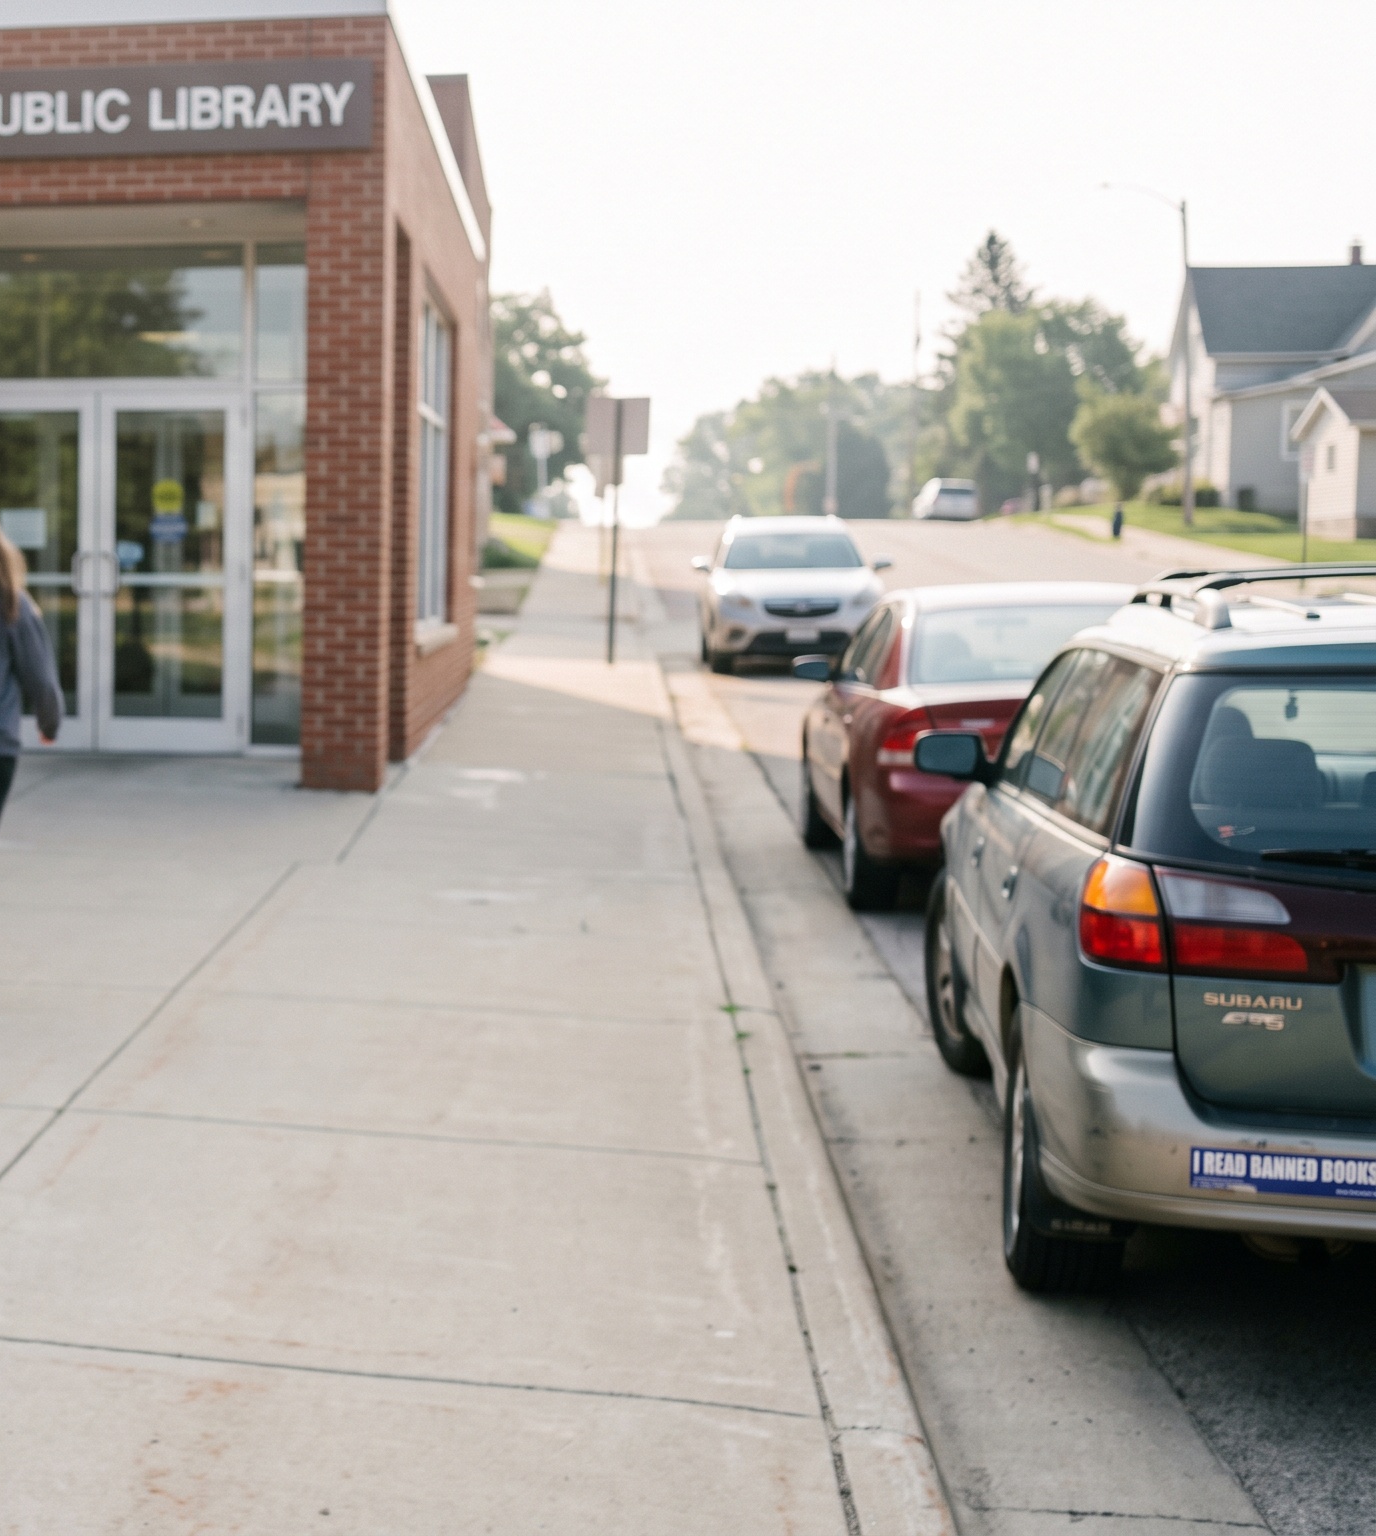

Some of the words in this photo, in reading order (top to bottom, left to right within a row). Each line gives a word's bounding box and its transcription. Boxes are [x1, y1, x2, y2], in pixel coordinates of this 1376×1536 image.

[147, 81, 355, 132] LIBRARY
[1203, 992, 1302, 1010] SUBARU
[1193, 1150, 1200, 1174] I
[1203, 1151, 1247, 1177] READ
[1250, 1154, 1318, 1182] BANNED
[1321, 1159, 1376, 1186] BOOKS
